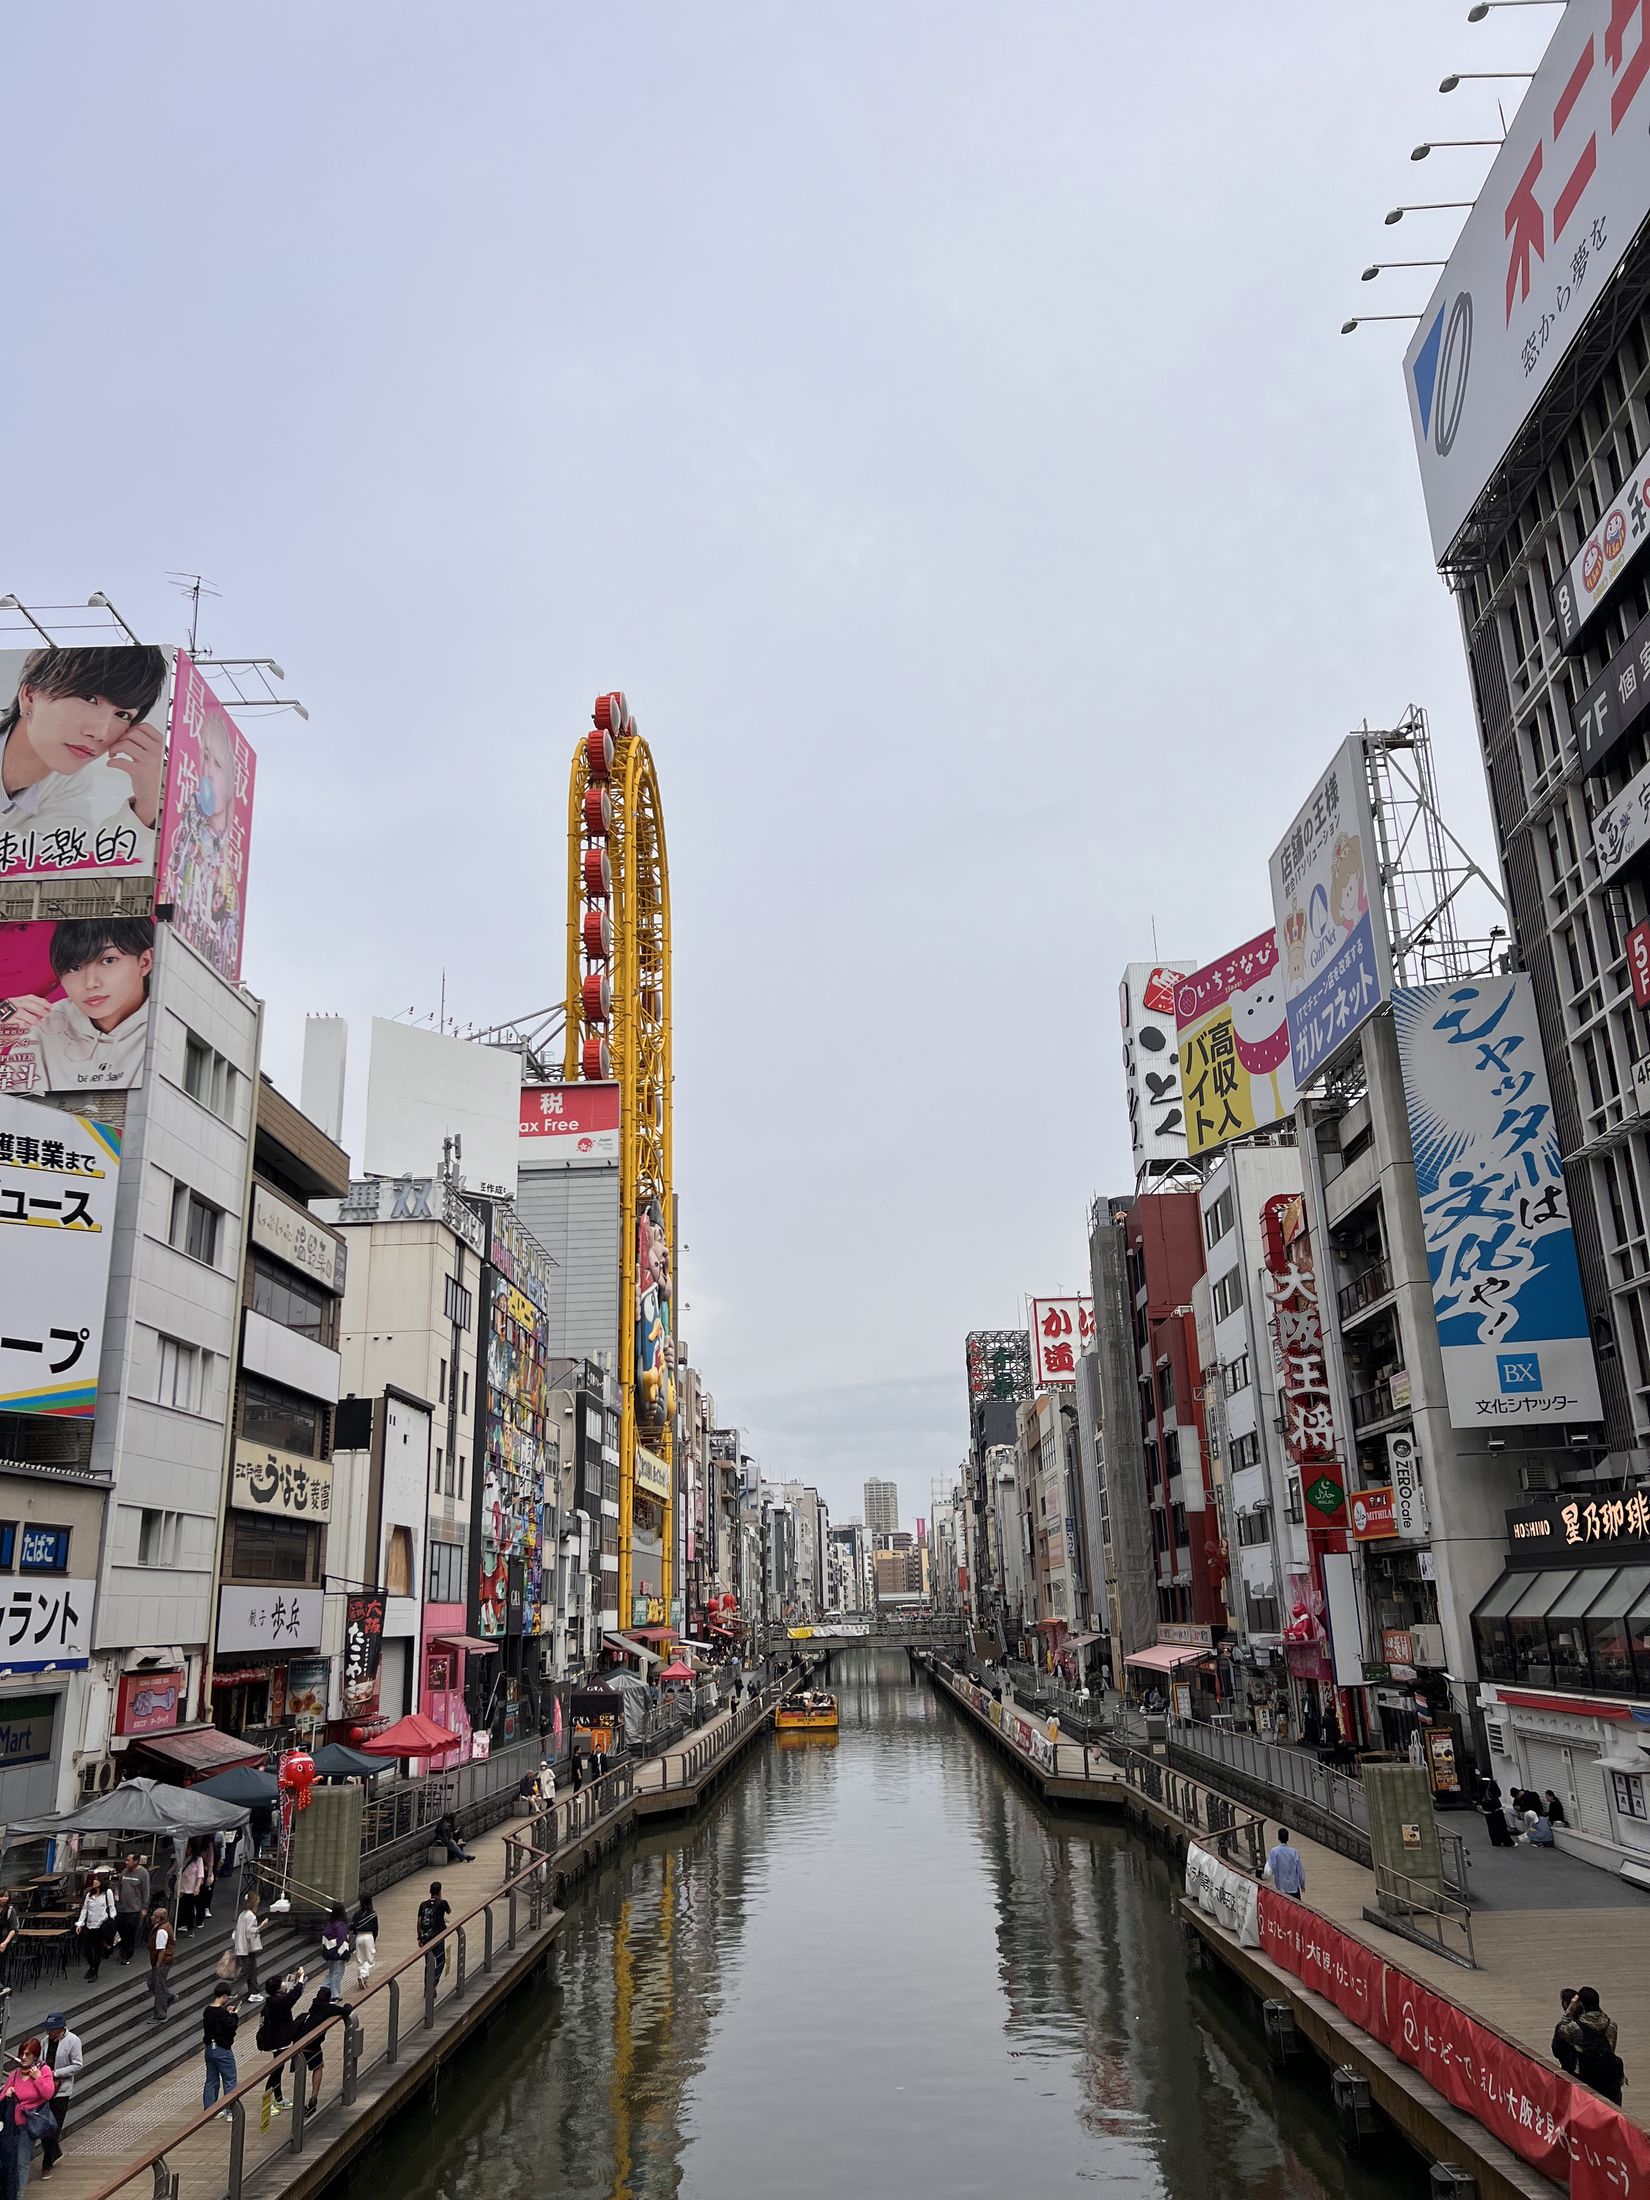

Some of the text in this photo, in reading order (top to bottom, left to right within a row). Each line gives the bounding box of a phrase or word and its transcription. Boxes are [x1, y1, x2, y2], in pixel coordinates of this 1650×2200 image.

[1520, 215, 1607, 378] 窓から夢を
[1558, 585, 1572, 637] 8F
[1579, 690, 1608, 751] 7F
[0, 825, 137, 870] 刺激的
[1280, 770, 1340, 885] 店舗の王様
[1197, 942, 1272, 998] いちごなび
[1633, 933, 1650, 995] 5F
[1296, 961, 1374, 1073] ガルフネット
[1, 1053, 34, 1062] PLAYER
[1208, 1018, 1243, 1137] 高収入
[540, 1092, 564, 1115] 税
[1185, 1030, 1214, 1146] バイト
[544, 1118, 580, 1131] Free
[1043, 1342, 1075, 1373] 道
[1266, 1262, 1335, 1450] 大阪王将
[1503, 1364, 1537, 1384] BX
[249, 1453, 310, 1511] うなぎ
[1315, 1488, 1335, 1500] حلال
[1395, 1460, 1413, 1529] ZERO cafe
[1366, 1509, 1393, 1521] MITHILA
[1513, 1519, 1551, 1539] HOSHINO
[1560, 1490, 1650, 1545] 星乃珈琲
[21, 1533, 55, 1563] たばこ
[271, 1595, 301, 1641] 歩兵
[365, 1599, 382, 1634] 大阪
